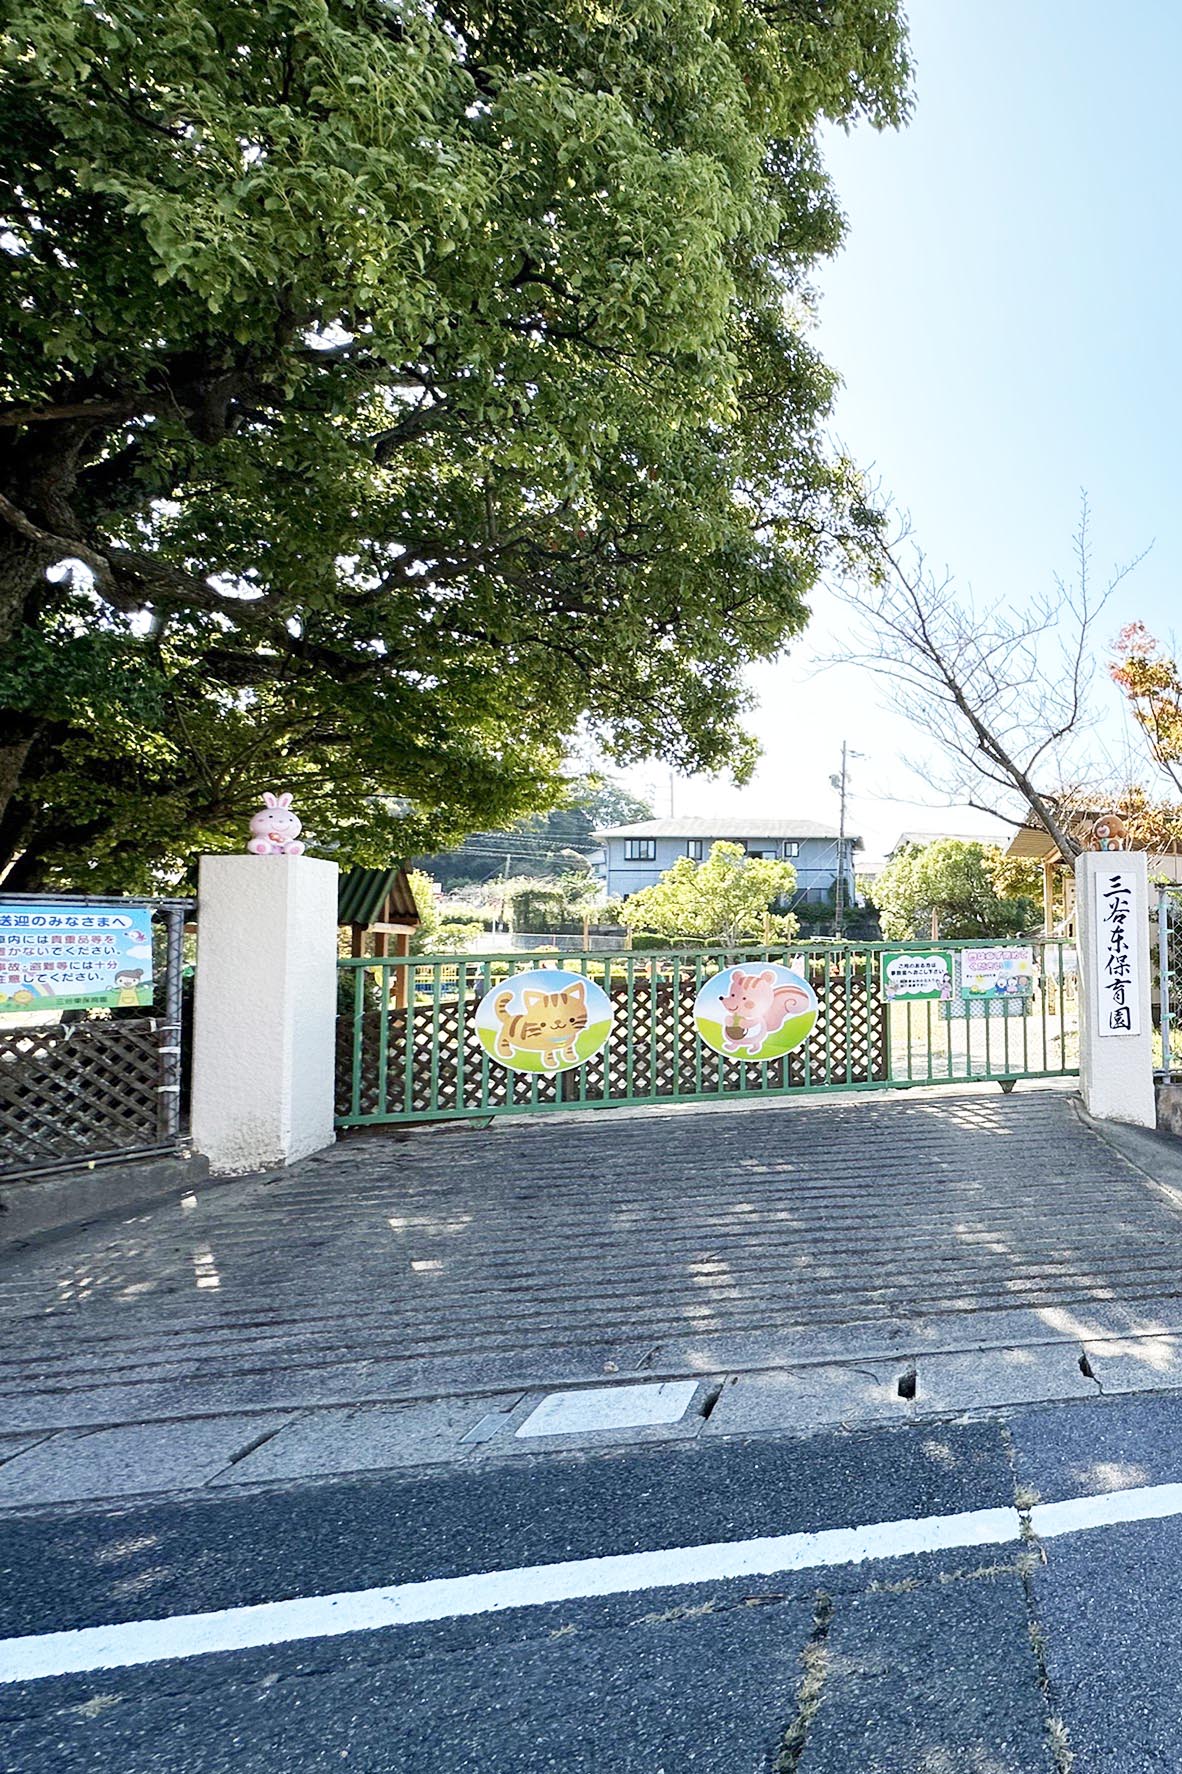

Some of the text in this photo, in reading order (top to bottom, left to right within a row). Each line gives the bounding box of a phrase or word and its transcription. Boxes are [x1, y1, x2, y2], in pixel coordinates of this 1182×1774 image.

[0, 915, 126, 927] 送迎のみなさまへ
